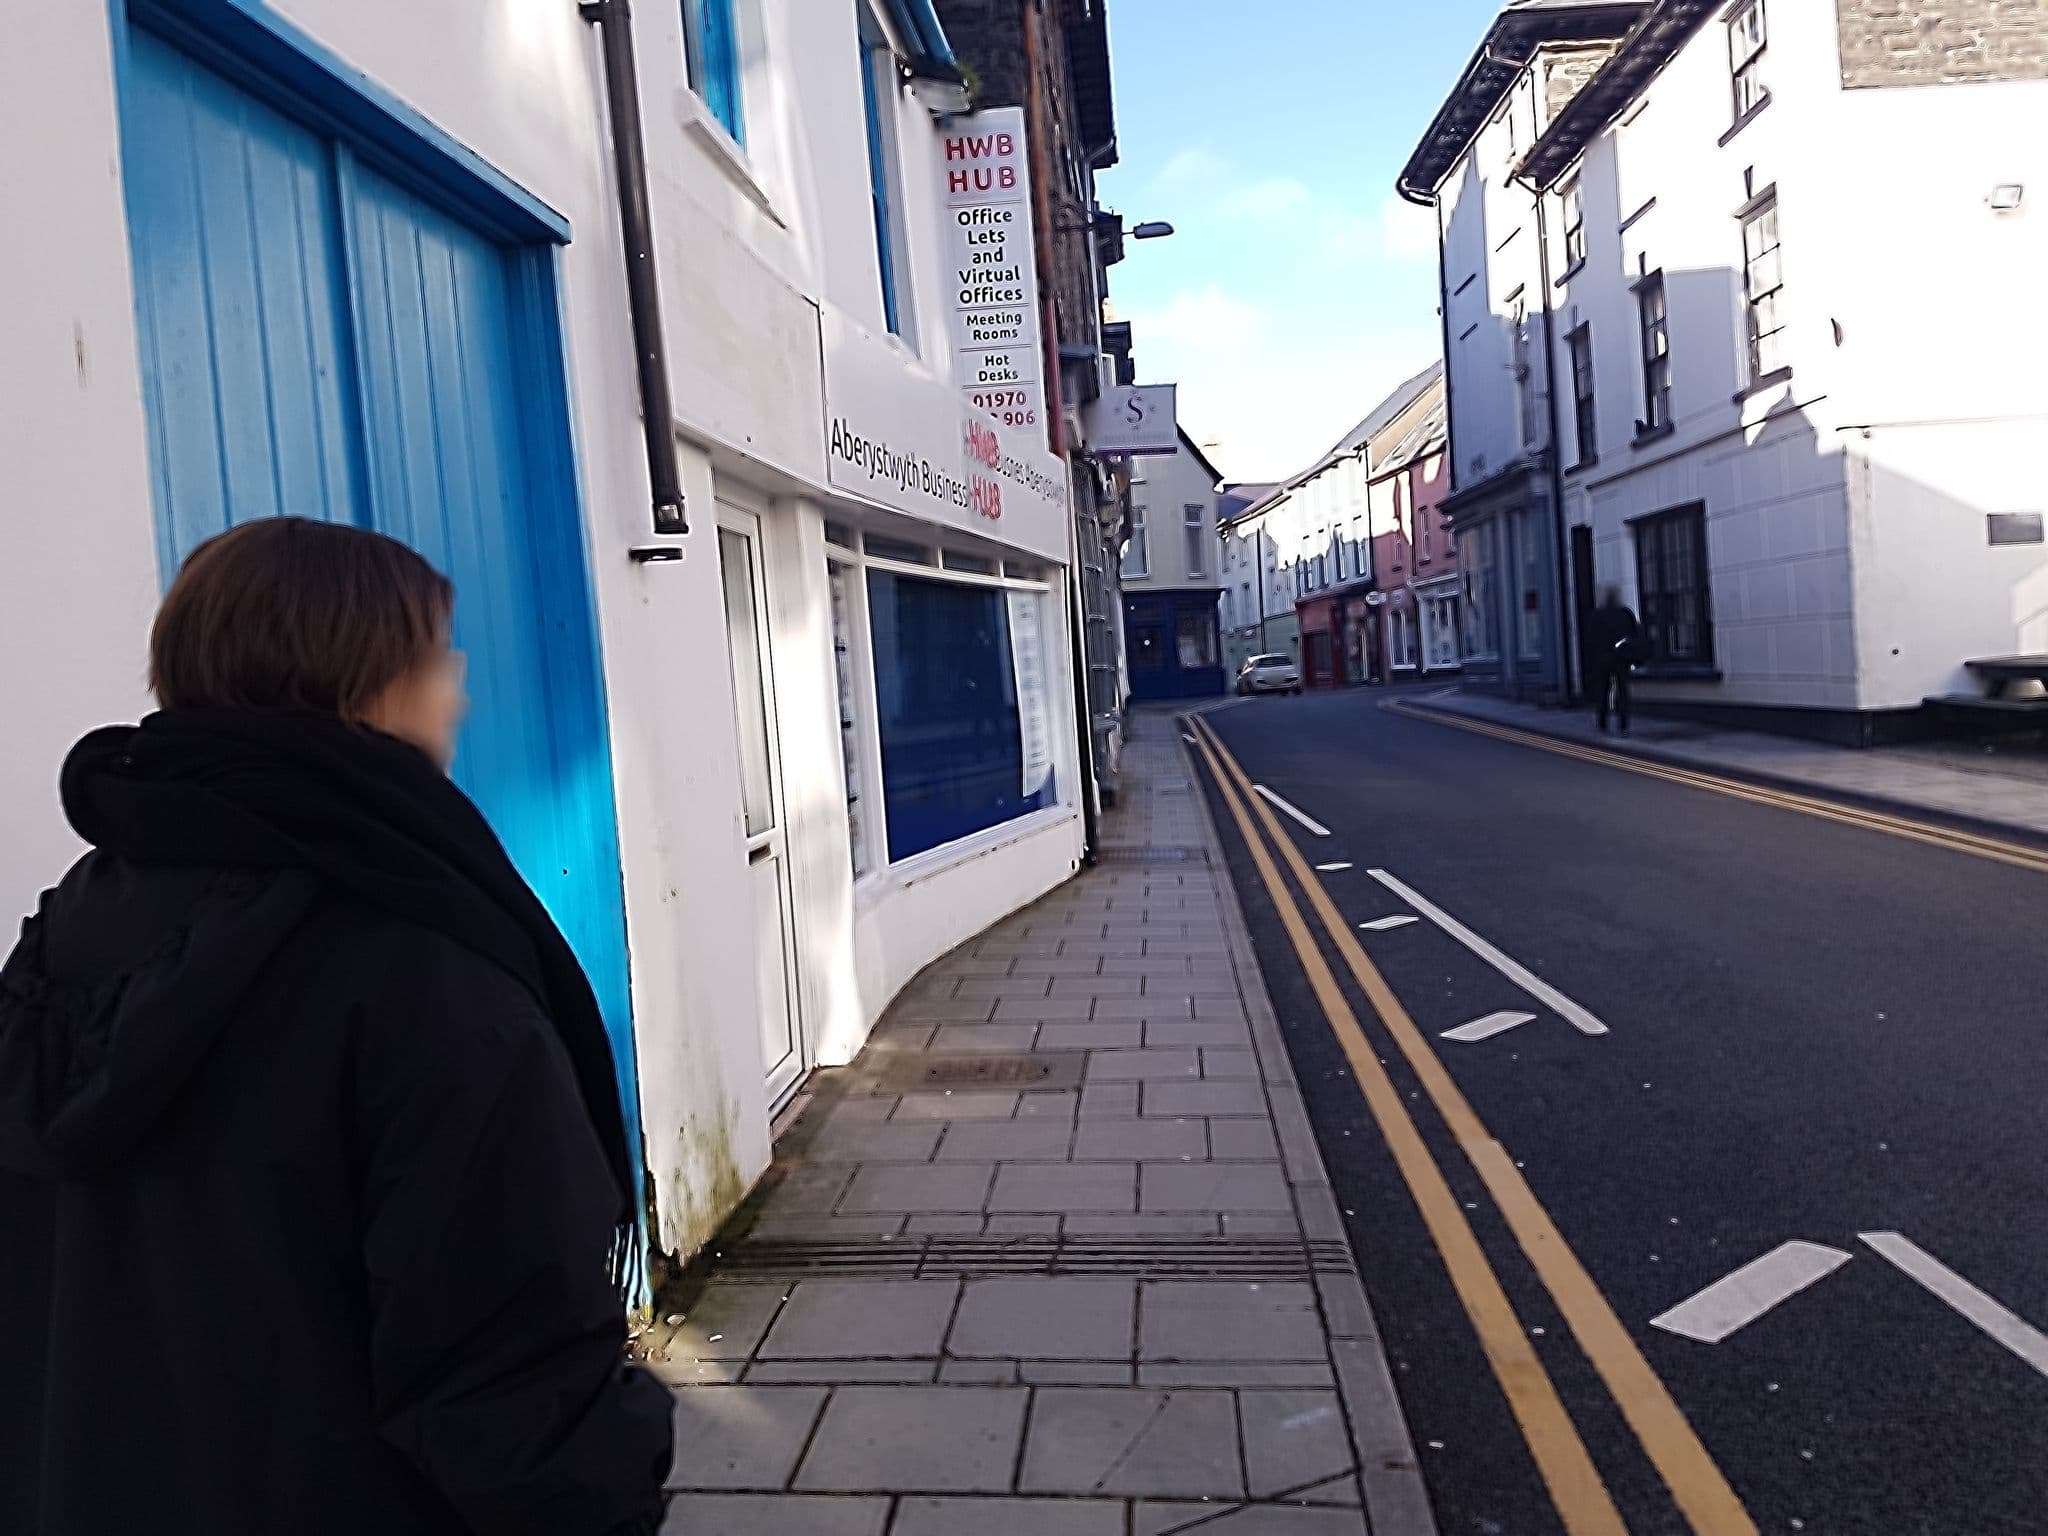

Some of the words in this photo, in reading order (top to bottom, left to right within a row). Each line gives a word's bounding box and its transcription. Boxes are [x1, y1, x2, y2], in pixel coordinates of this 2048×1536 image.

[945, 134, 1014, 160] HWB
[949, 166, 1016, 193] HUB
[958, 208, 1012, 226] Office
[968, 229, 1006, 245] Lets
[972, 247, 1003, 264] and
[958, 265, 1020, 284] Virtual
[959, 287, 1023, 304] Offices
[966, 312, 1022, 326] Meeting
[973, 329, 1018, 340] Rooms
[984, 355, 1010, 367] Hot
[978, 369, 1018, 382] Desks
[973, 391, 1027, 408] 01970
[831, 417, 920, 492] Aberystwyth
[922, 459, 968, 508] Business
